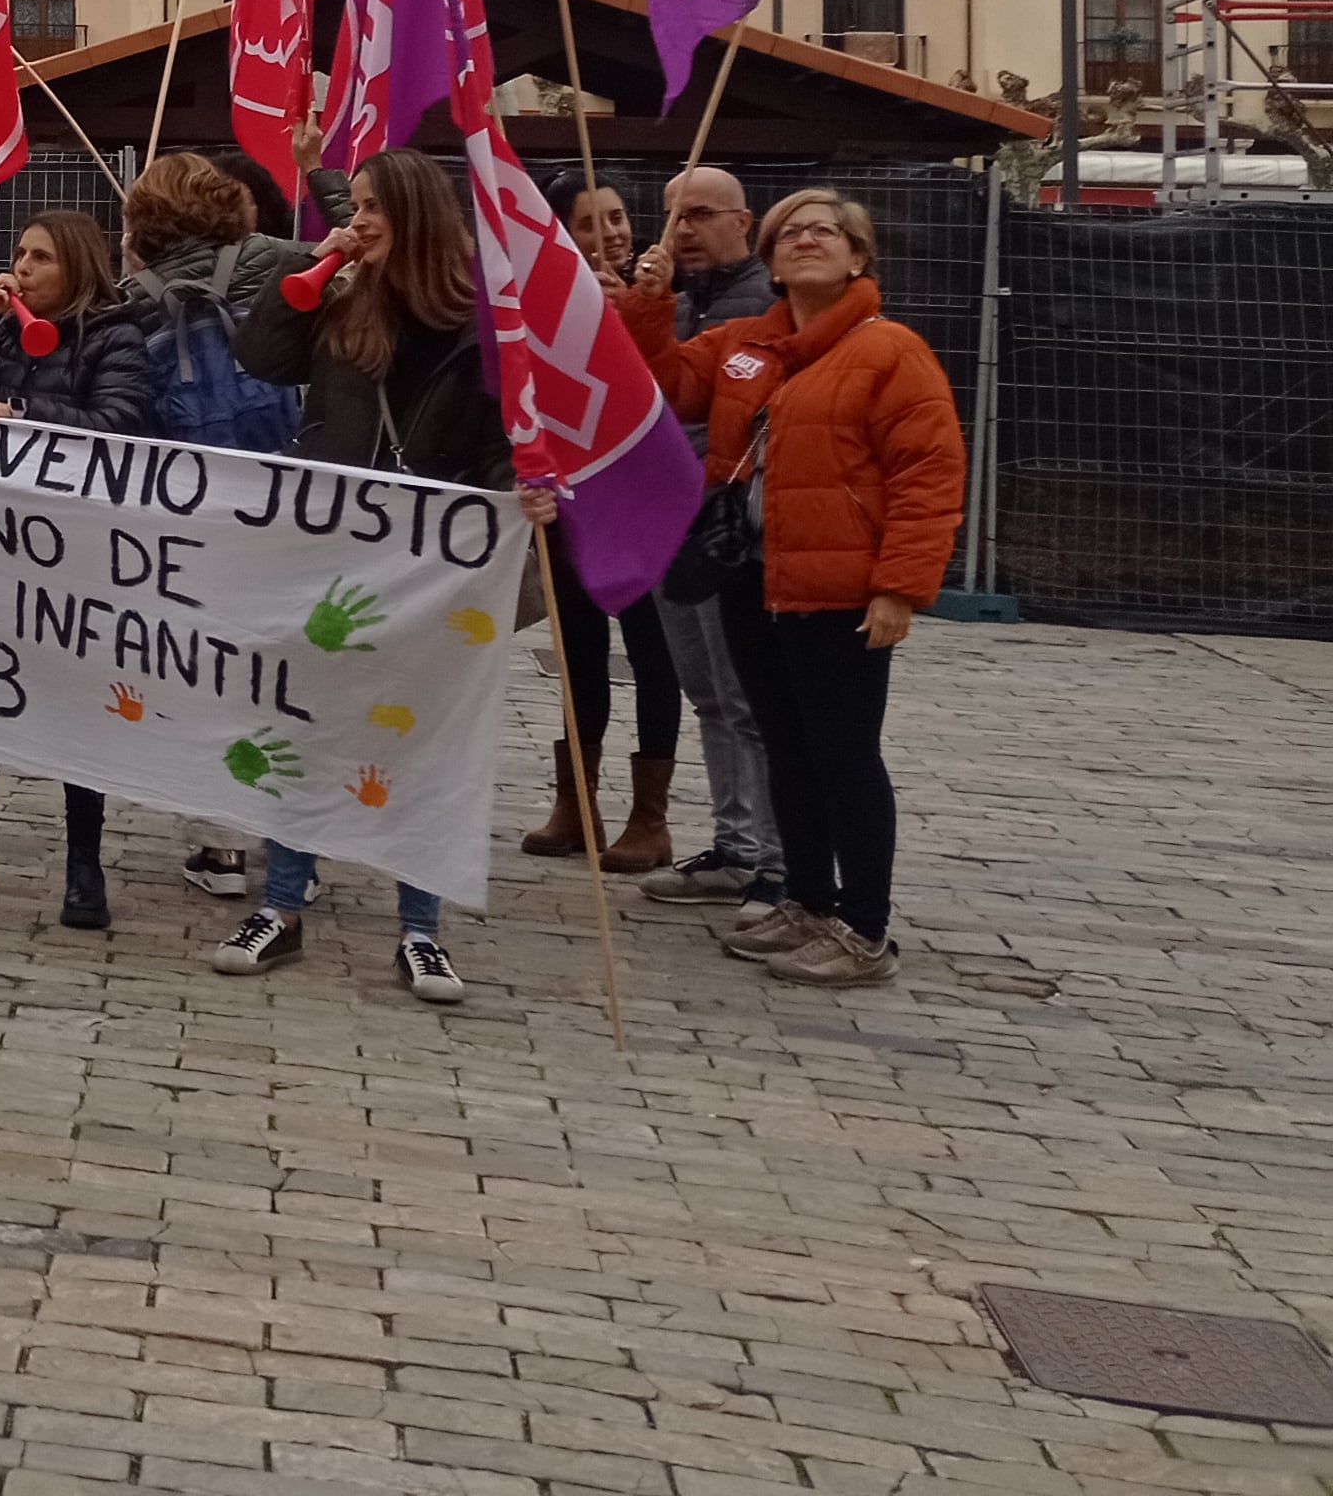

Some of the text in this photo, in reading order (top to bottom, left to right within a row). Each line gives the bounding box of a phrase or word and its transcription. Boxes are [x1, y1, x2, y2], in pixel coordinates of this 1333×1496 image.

[110, 528, 205, 608] DE
[234, 460, 499, 568] JUSTO
[16, 580, 315, 722] INFANTIL
